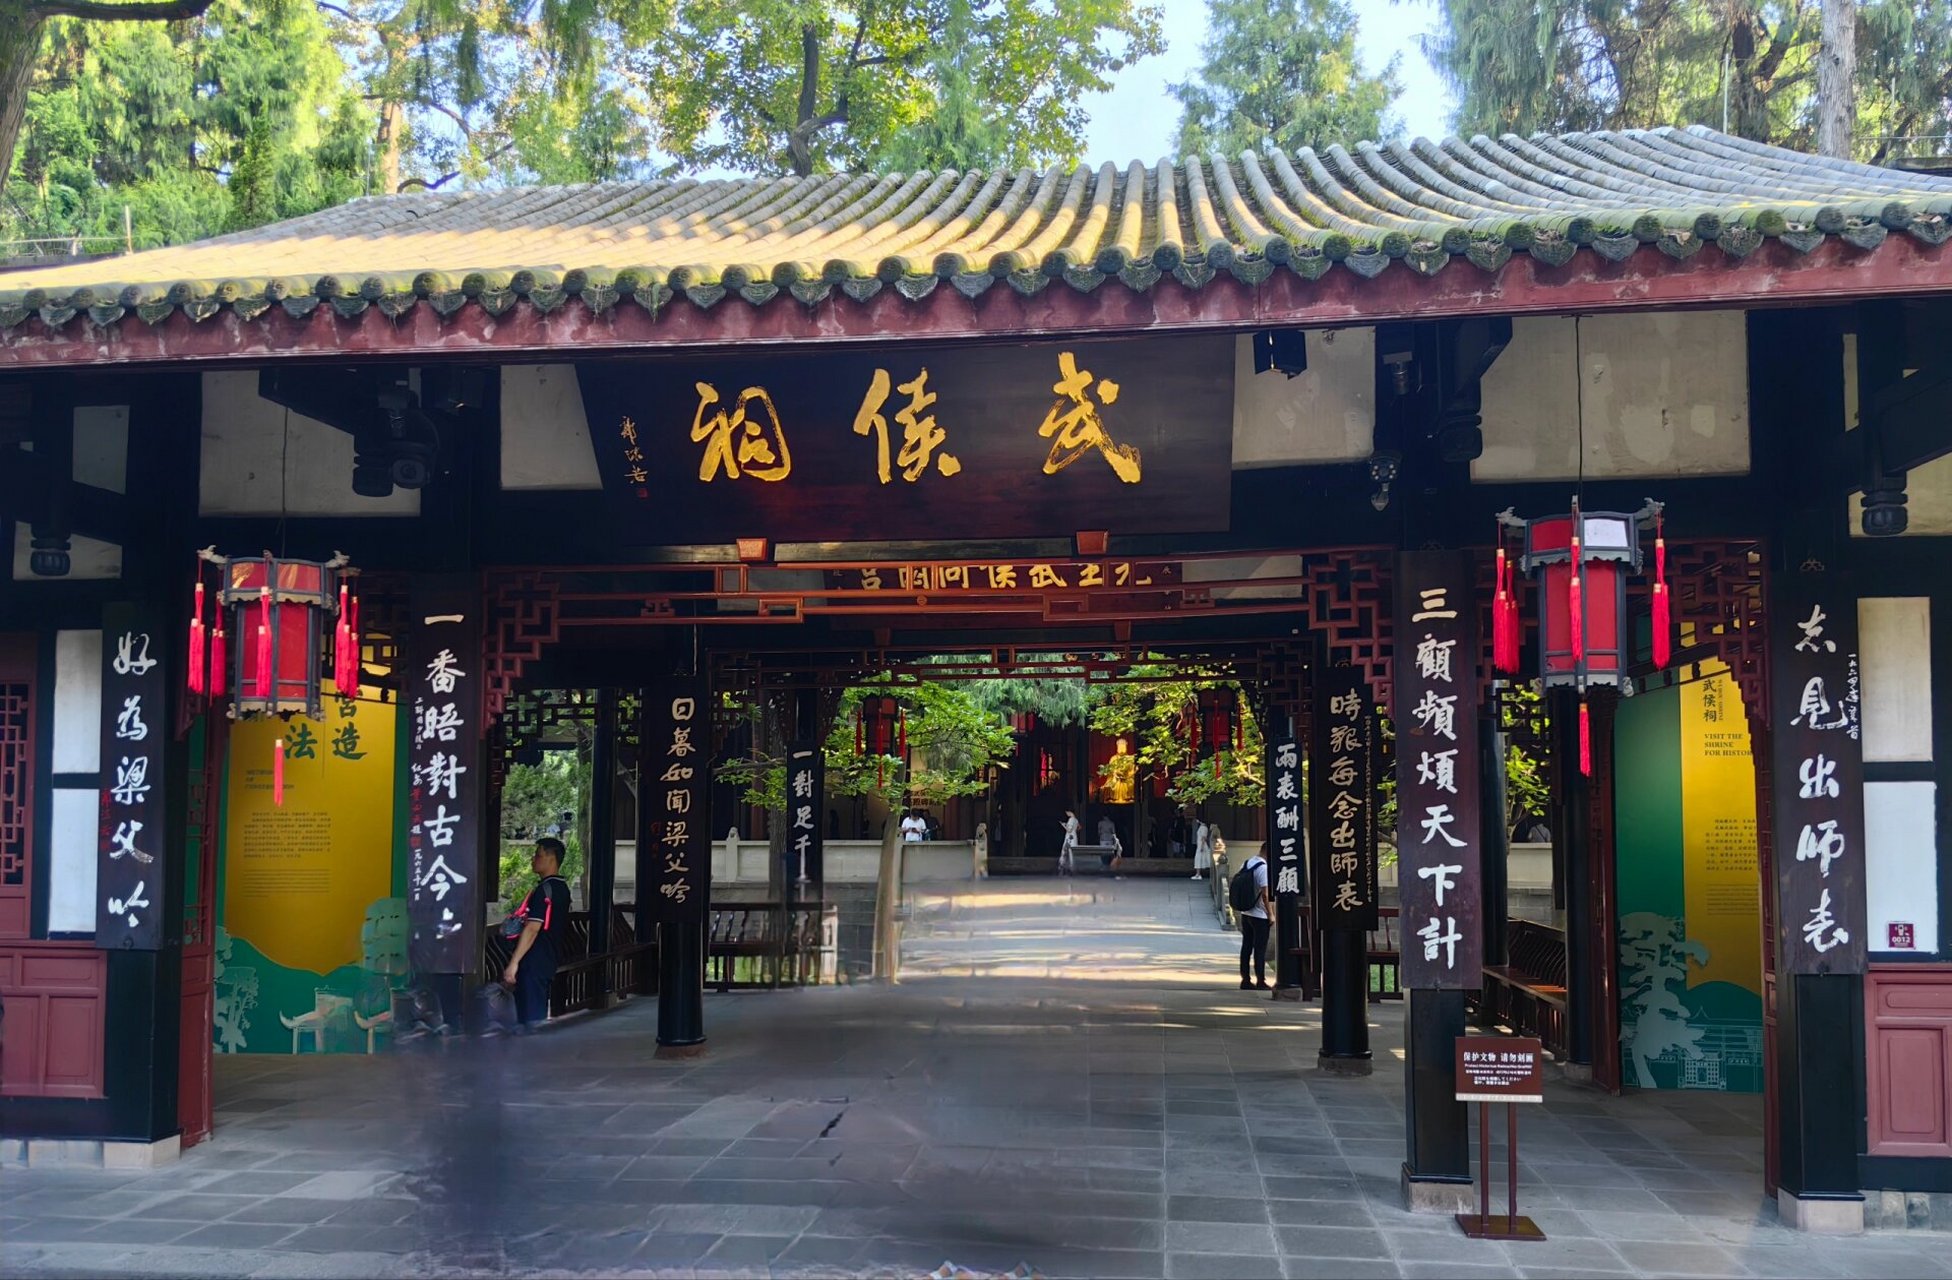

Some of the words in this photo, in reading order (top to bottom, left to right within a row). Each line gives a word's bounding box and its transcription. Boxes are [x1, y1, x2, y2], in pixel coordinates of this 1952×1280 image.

[1703, 679, 1716, 722] 武侯祠
[284, 722, 318, 760] 法
[1704, 749, 1721, 757] FOR
